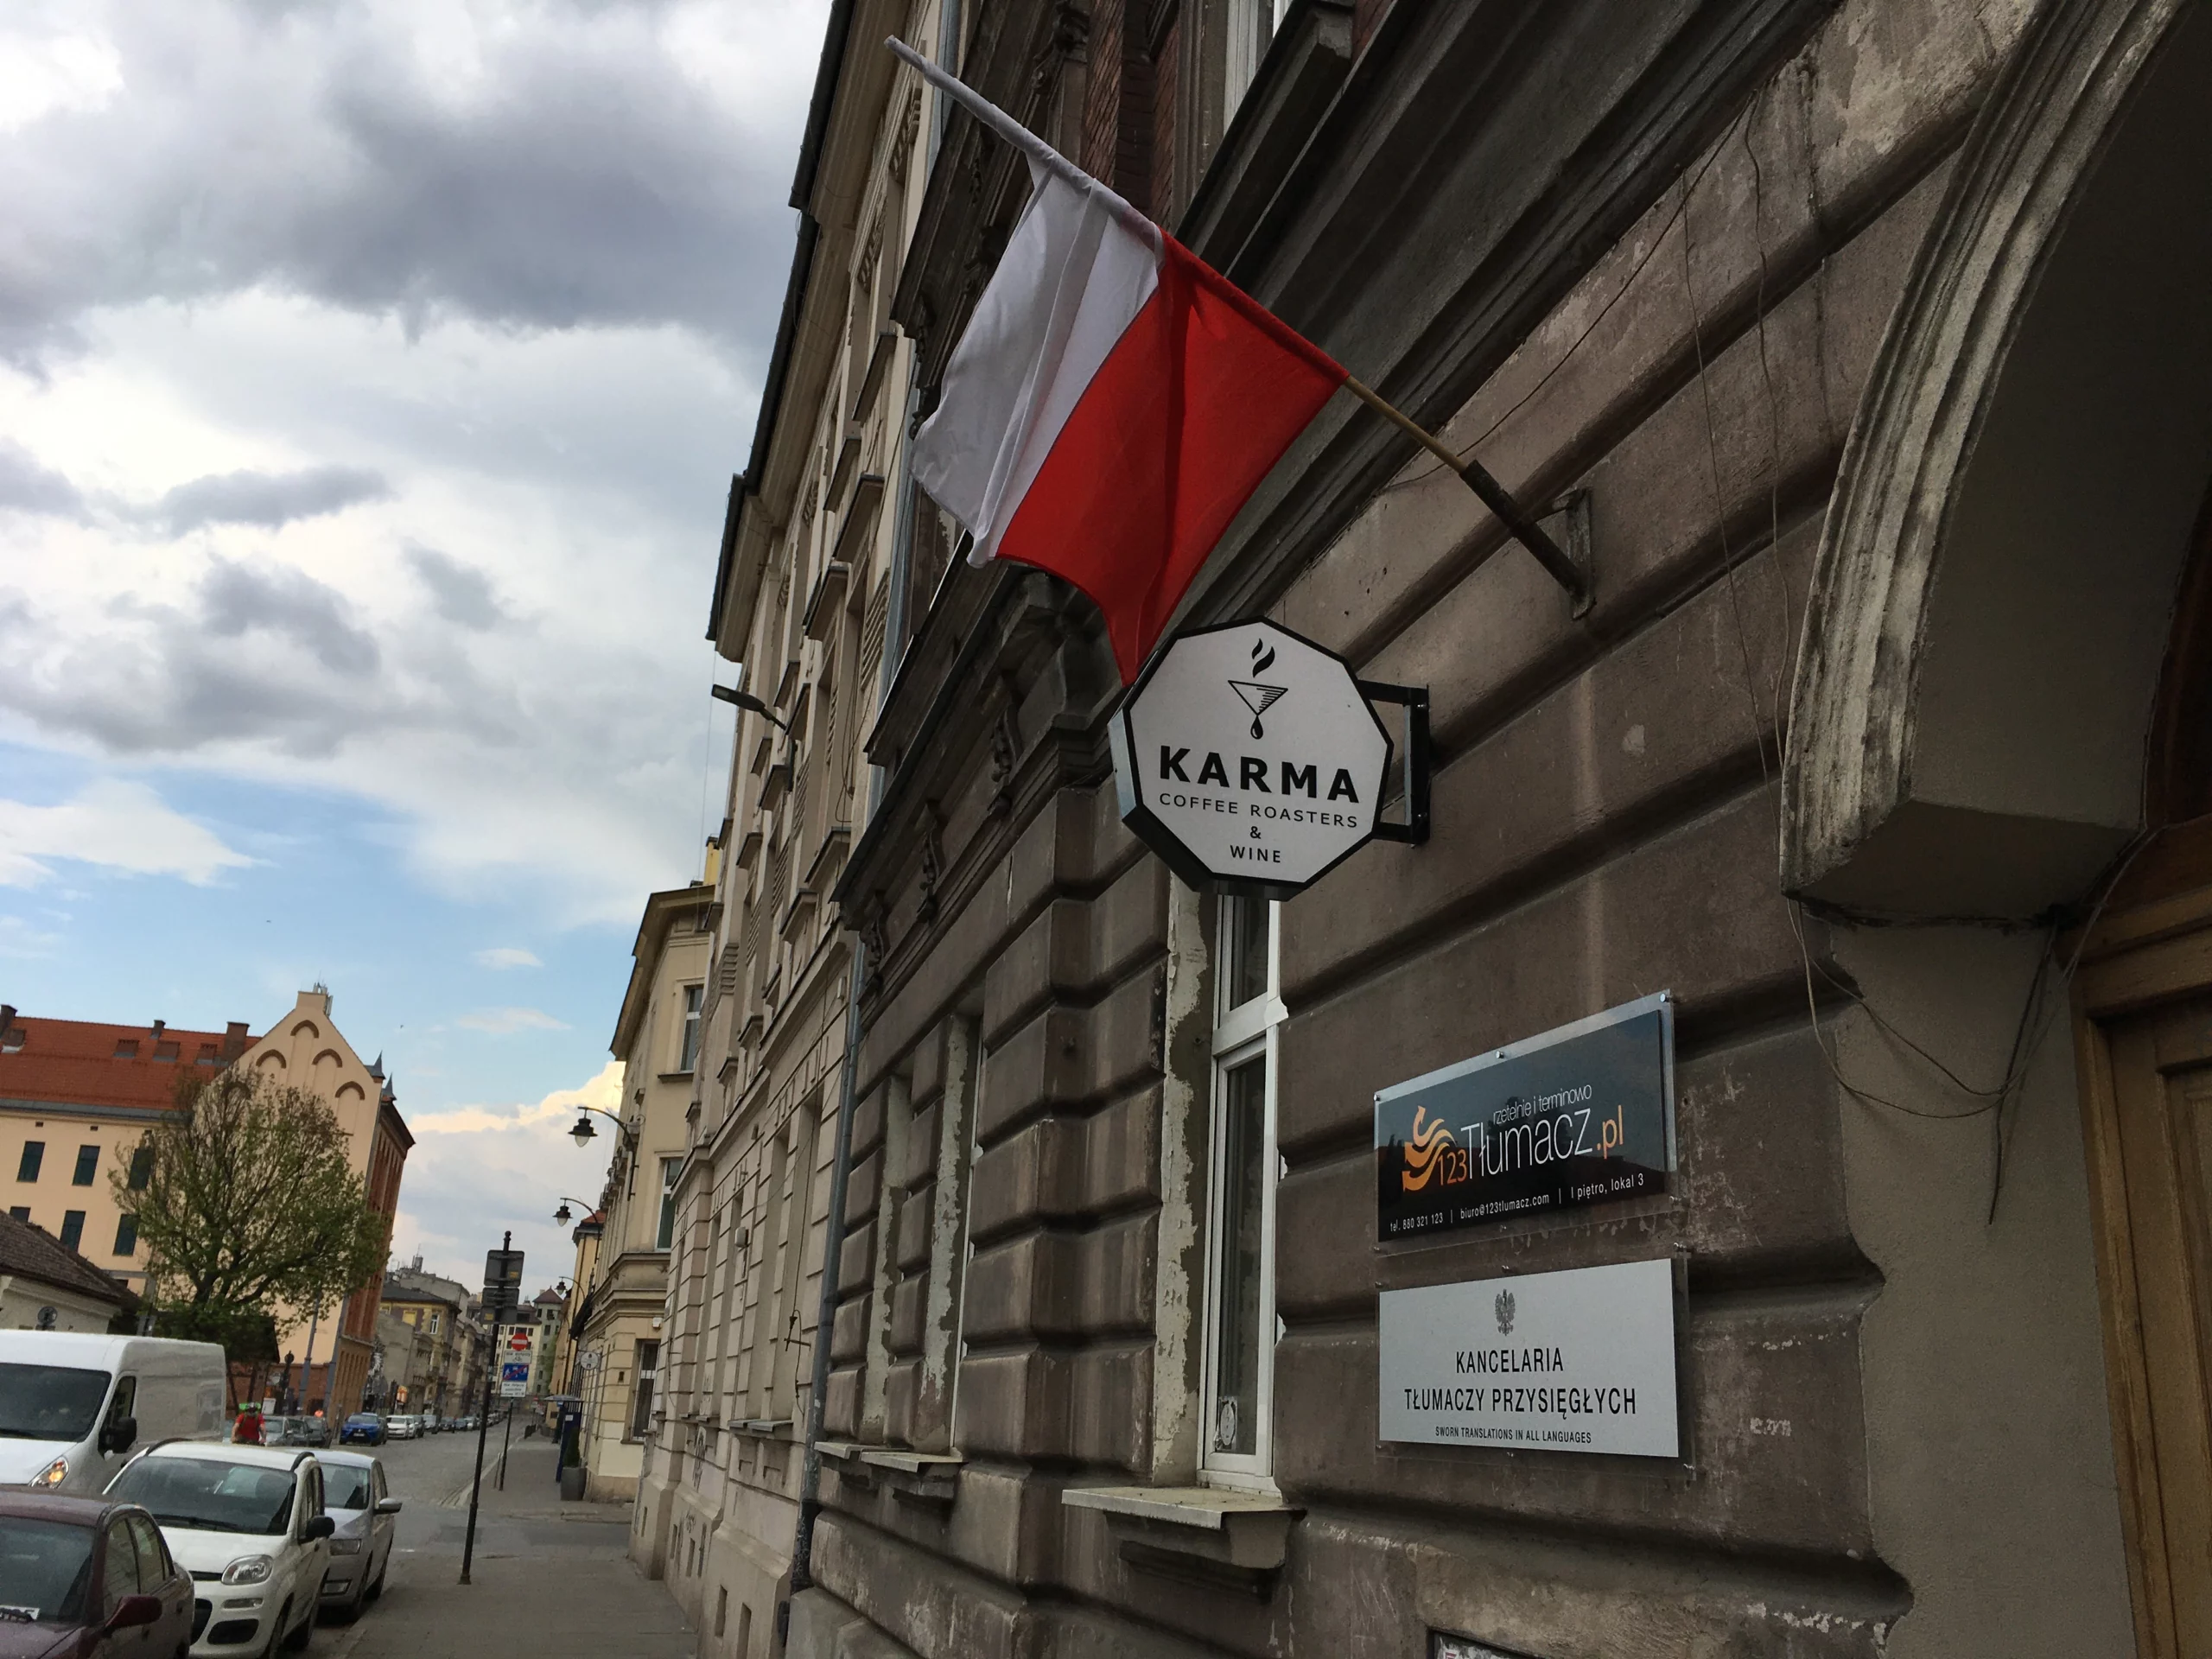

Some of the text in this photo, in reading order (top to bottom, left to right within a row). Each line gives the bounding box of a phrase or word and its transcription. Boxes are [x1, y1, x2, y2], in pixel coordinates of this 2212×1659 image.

[1160, 745, 1359, 803] KARMA
[1160, 793, 1358, 829] COFFEE ROASTERS
[1249, 826, 1262, 840] &
[1230, 844, 1281, 864] WINE
[1493, 1101, 1531, 1125] rzetelnie
[1538, 1084, 1592, 1113] terminowo
[1431, 1212, 1443, 1224] 123
[1460, 1193, 1549, 1219] biuro@123tlumacz.com
[1611, 1177, 1635, 1192] lokal
[1637, 1173, 1644, 1186] 3
[1456, 1347, 1564, 1374] KANCELARIA
[1404, 1388, 1636, 1420] TŁUMACZY PRZYSIĘGŁYCH
[1435, 1426, 1592, 1444] SWORN TRANSLATIONS IN ALL LANGUAGES
